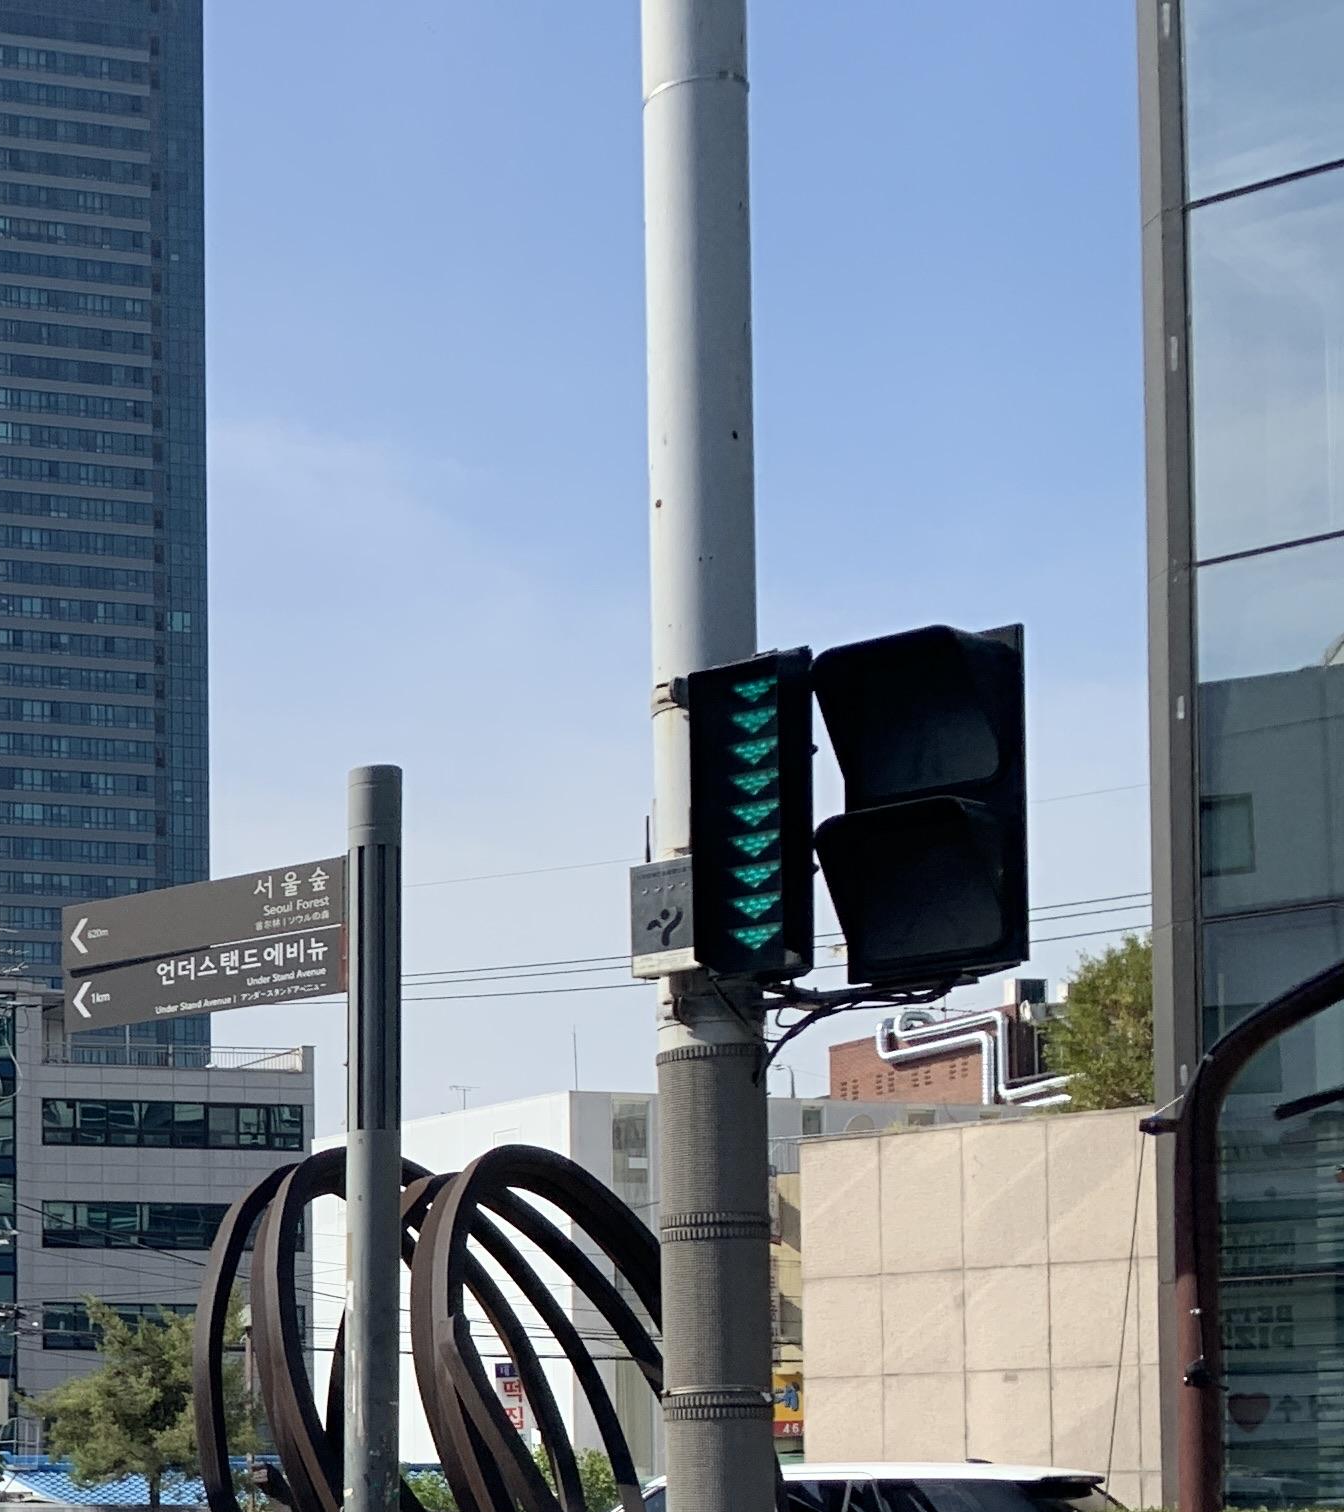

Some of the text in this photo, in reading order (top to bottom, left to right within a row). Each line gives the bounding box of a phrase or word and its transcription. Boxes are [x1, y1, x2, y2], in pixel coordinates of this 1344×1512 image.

[254, 867, 330, 899] 서울숲
[263, 896, 330, 916] Seoul Forest
[157, 938, 328, 985] 언더스탠드에비뉴
[246, 967, 327, 986] Under Stand Avenue
[155, 1003, 179, 1015] Under
[180, 999, 202, 1011] Stand
[202, 996, 232, 1008] Avenue
[503, 1379, 523, 1430] 떡집
